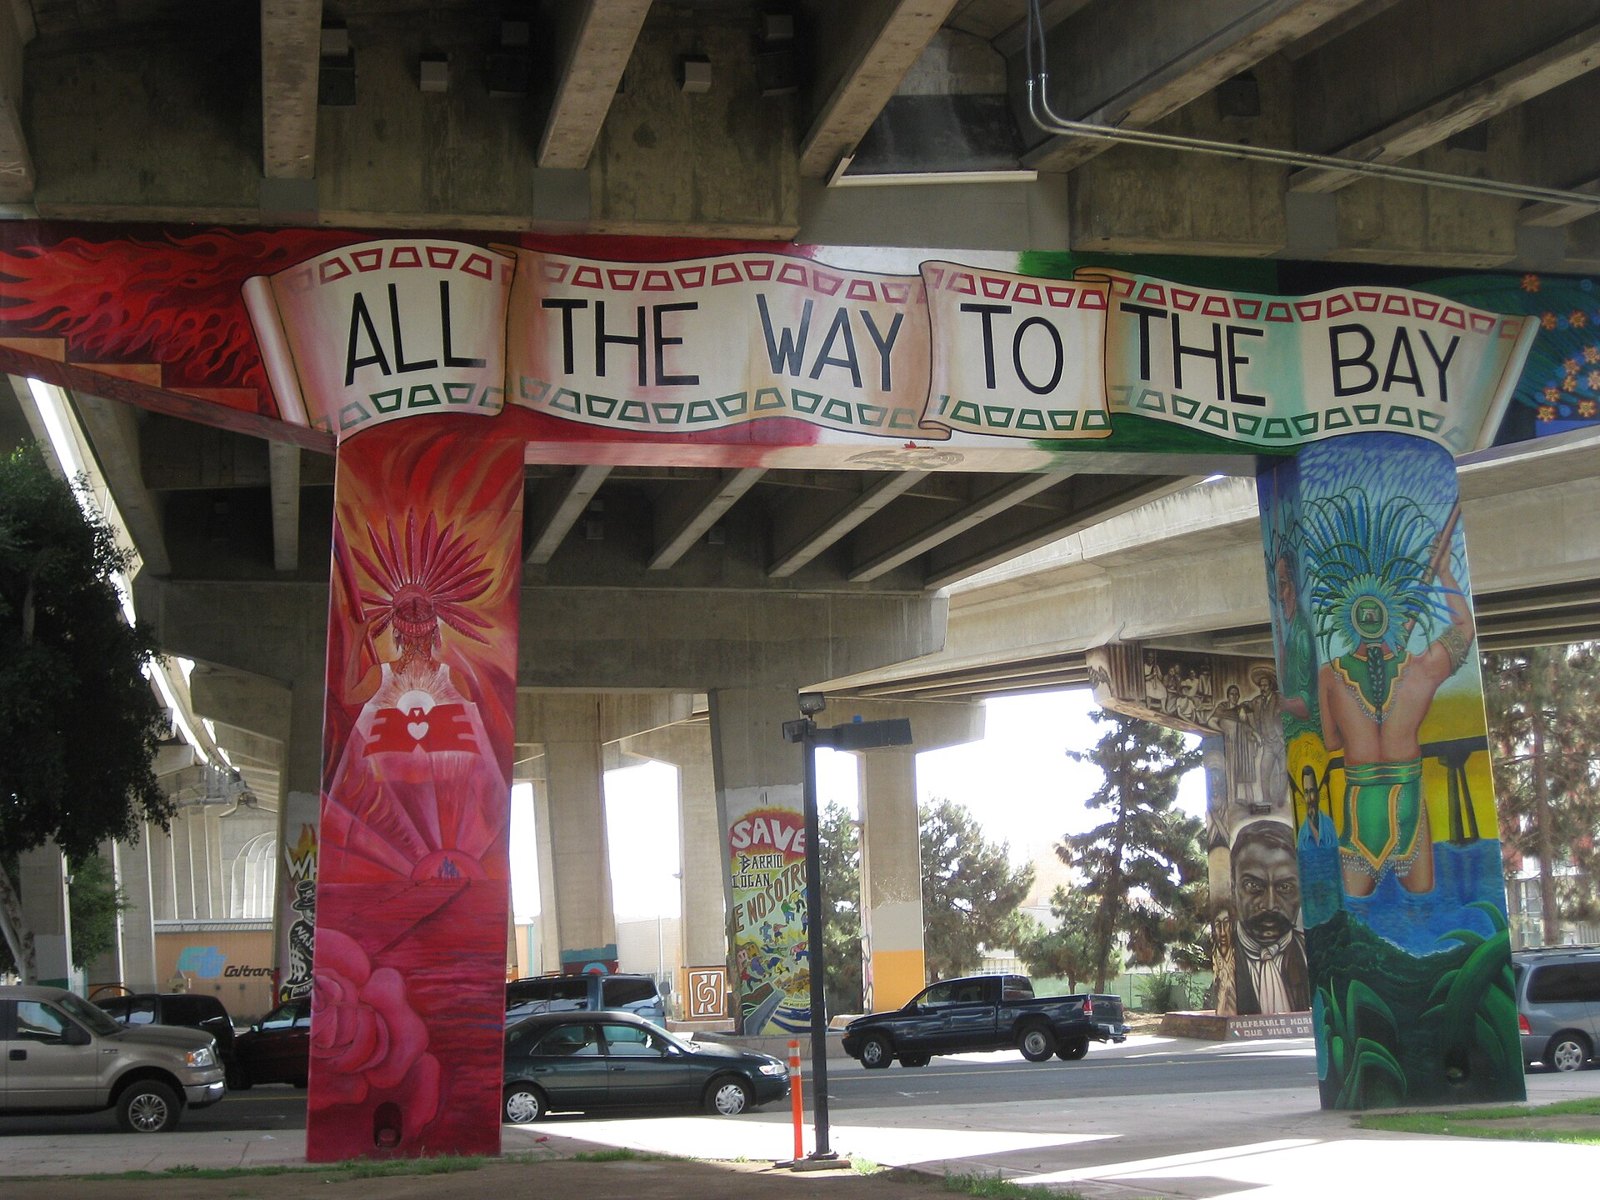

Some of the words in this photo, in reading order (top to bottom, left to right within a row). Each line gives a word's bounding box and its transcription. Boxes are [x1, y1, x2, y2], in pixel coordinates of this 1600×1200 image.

[345, 280, 487, 387] ALL
[541, 297, 700, 387] THE
[755, 293, 905, 392] WAY
[960, 303, 1064, 395] TO
[1119, 301, 1267, 407] THE
[1328, 323, 1461, 403] BAY
[731, 817, 805, 853] SAVE
[737, 852, 784, 873] BARRIO
[731, 872, 770, 889] LOGAN
